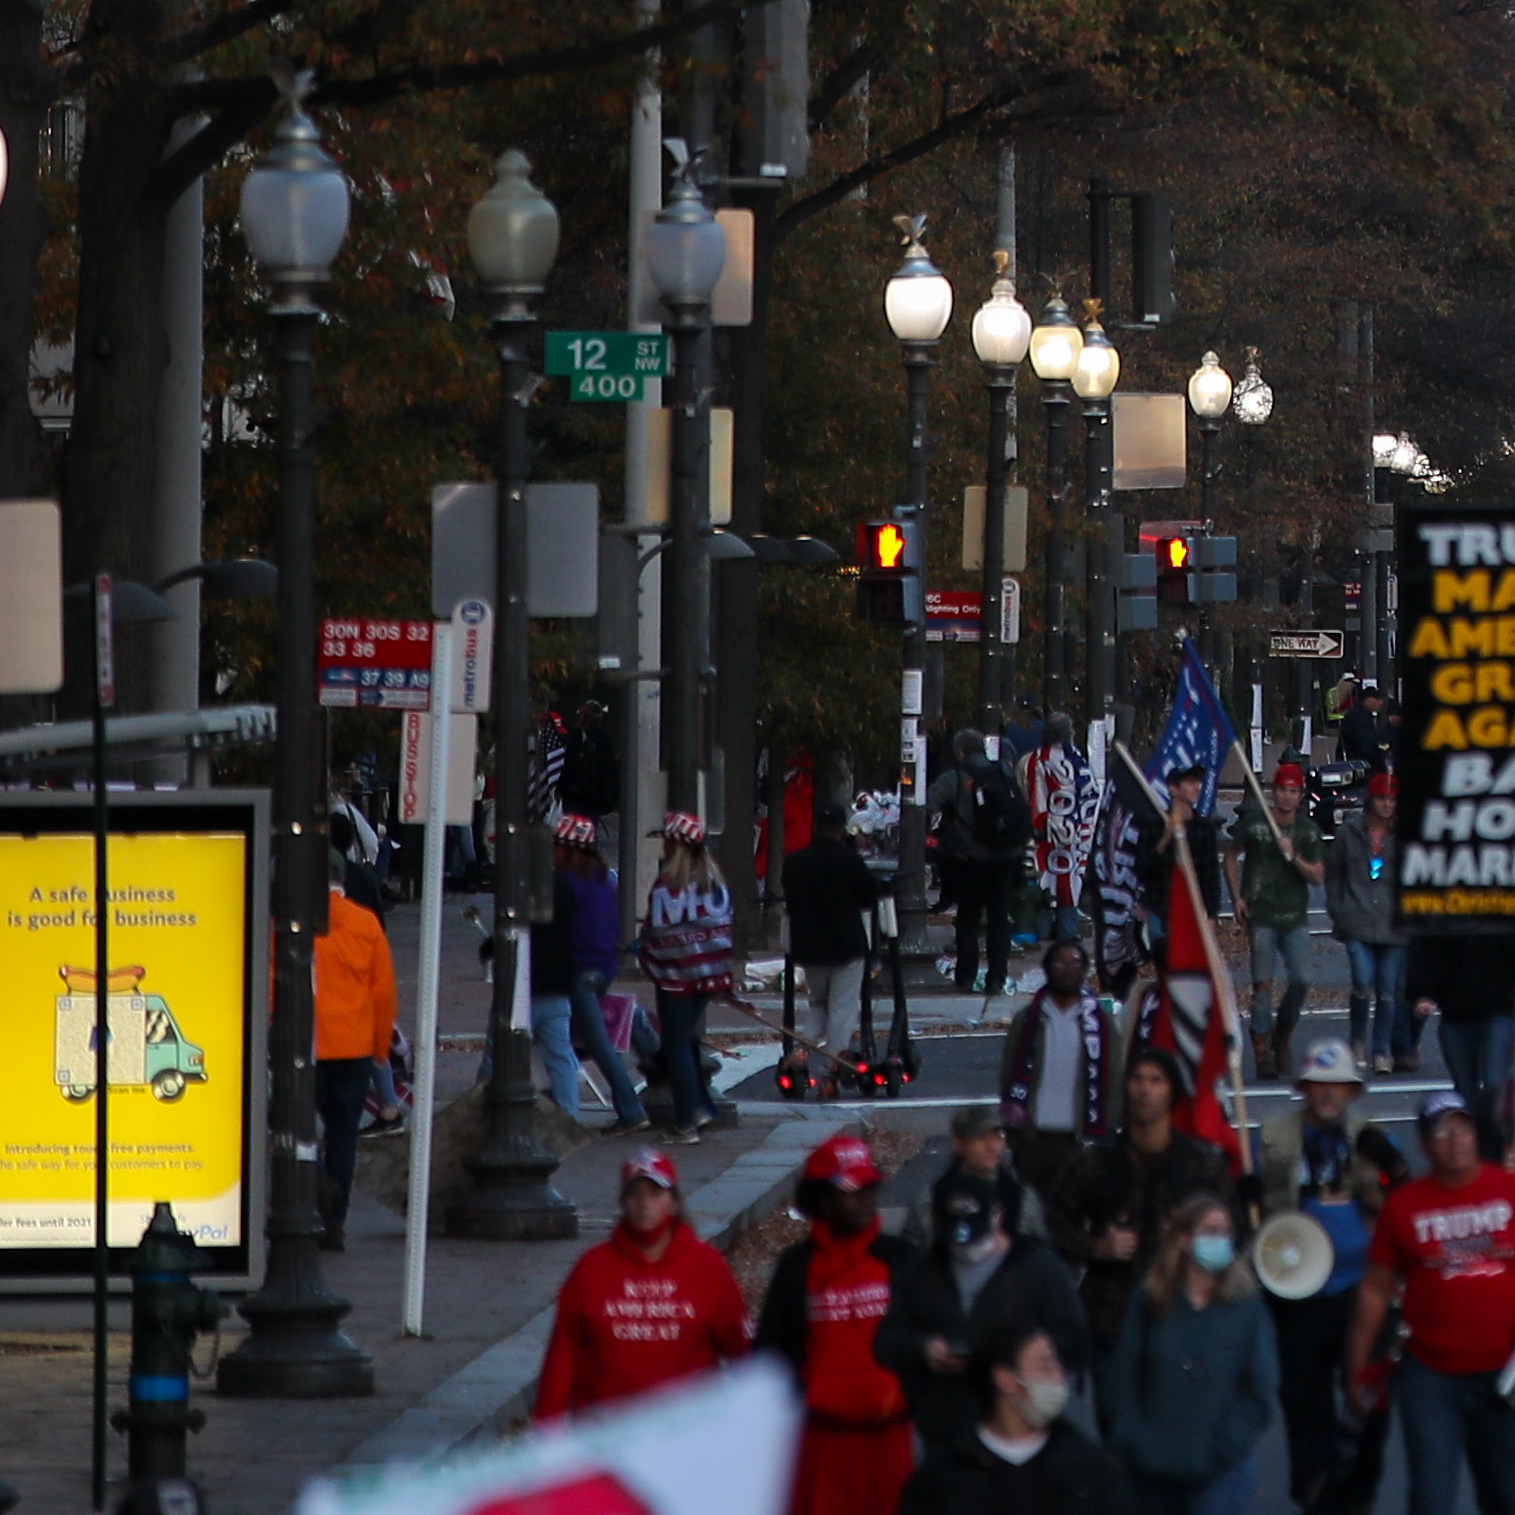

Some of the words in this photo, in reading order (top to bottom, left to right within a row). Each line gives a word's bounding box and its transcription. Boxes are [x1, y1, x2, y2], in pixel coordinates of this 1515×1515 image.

[567, 338, 607, 370] 12
[637, 342, 659, 356] ST
[635, 357, 660, 371] NW
[579, 375, 636, 398] 400
[323, 622, 360, 640] 30N
[365, 623, 401, 641] 30S
[406, 625, 429, 641] 32
[323, 641, 346, 657] 33
[352, 641, 376, 658] 36
[463, 628, 479, 707] metrobus
[361, 669, 381, 686] 37
[384, 670, 405, 687] 39
[29, 886, 43, 902] A
[50, 885, 87, 902] safe
[106, 885, 175, 902] usiness
[8, 911, 22, 927] is
[28, 909, 75, 932] good
[115, 909, 196, 927] business
[5, 1144, 70, 1156] Introducing
[137, 1144, 195, 1157] payments.
[0, 1160, 13, 1170] he
[64, 1159, 79, 1170] for
[110, 1160, 166, 1170] customers
[169, 1160, 182, 1170] to
[15, 1218, 37, 1228] fees
[39, 1217, 64, 1228] until
[66, 1218, 91, 1228] 2021
[1412, 1198, 1514, 1244] TRUMP
